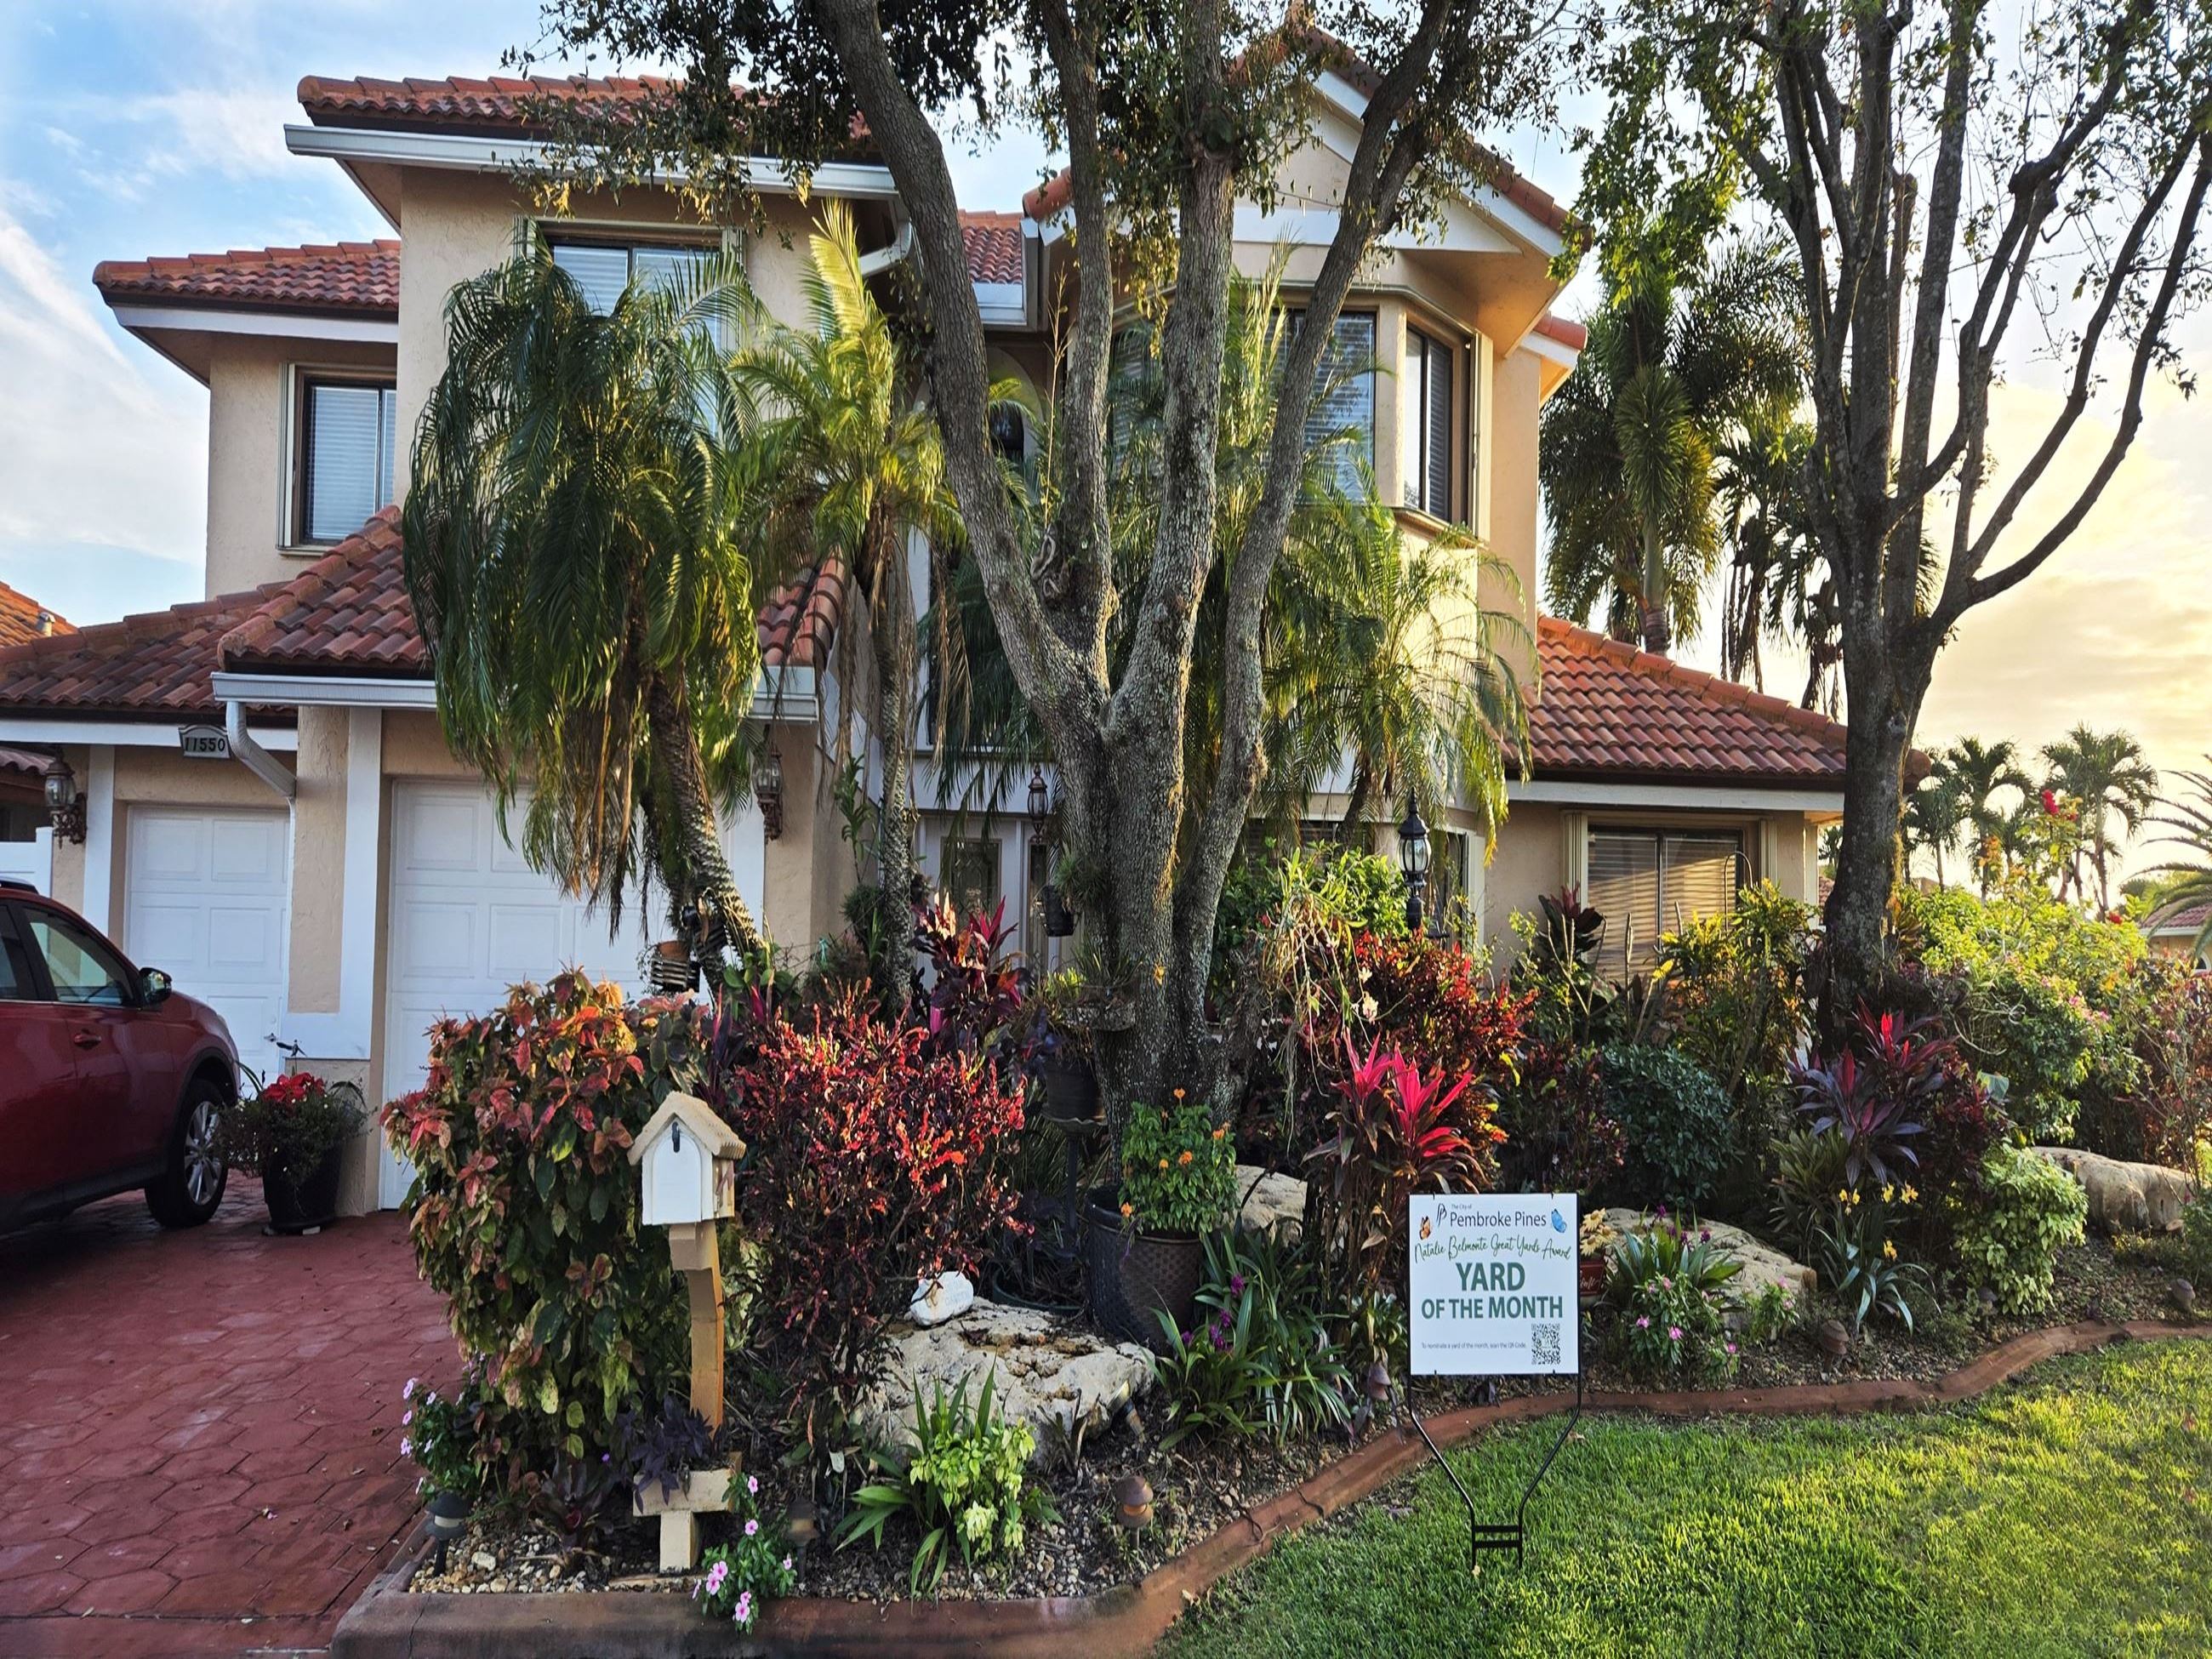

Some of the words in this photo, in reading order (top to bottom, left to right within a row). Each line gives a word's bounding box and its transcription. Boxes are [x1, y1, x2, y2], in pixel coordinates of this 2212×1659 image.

[185, 737, 225, 752] 11550
[1450, 1211, 1512, 1227] Pembroke
[1514, 1211, 1547, 1227] Pines
[1414, 1240, 1445, 1264] Natalie
[1448, 1234, 1488, 1262] Belmonte
[1491, 1233, 1516, 1257] Great
[1516, 1234, 1541, 1257] Yards
[1542, 1238, 1572, 1262] Award
[1456, 1263, 1525, 1291] YARD
[1422, 1299, 1445, 1319] OF
[1449, 1298, 1484, 1319] THE
[1488, 1297, 1563, 1319] MONTH
